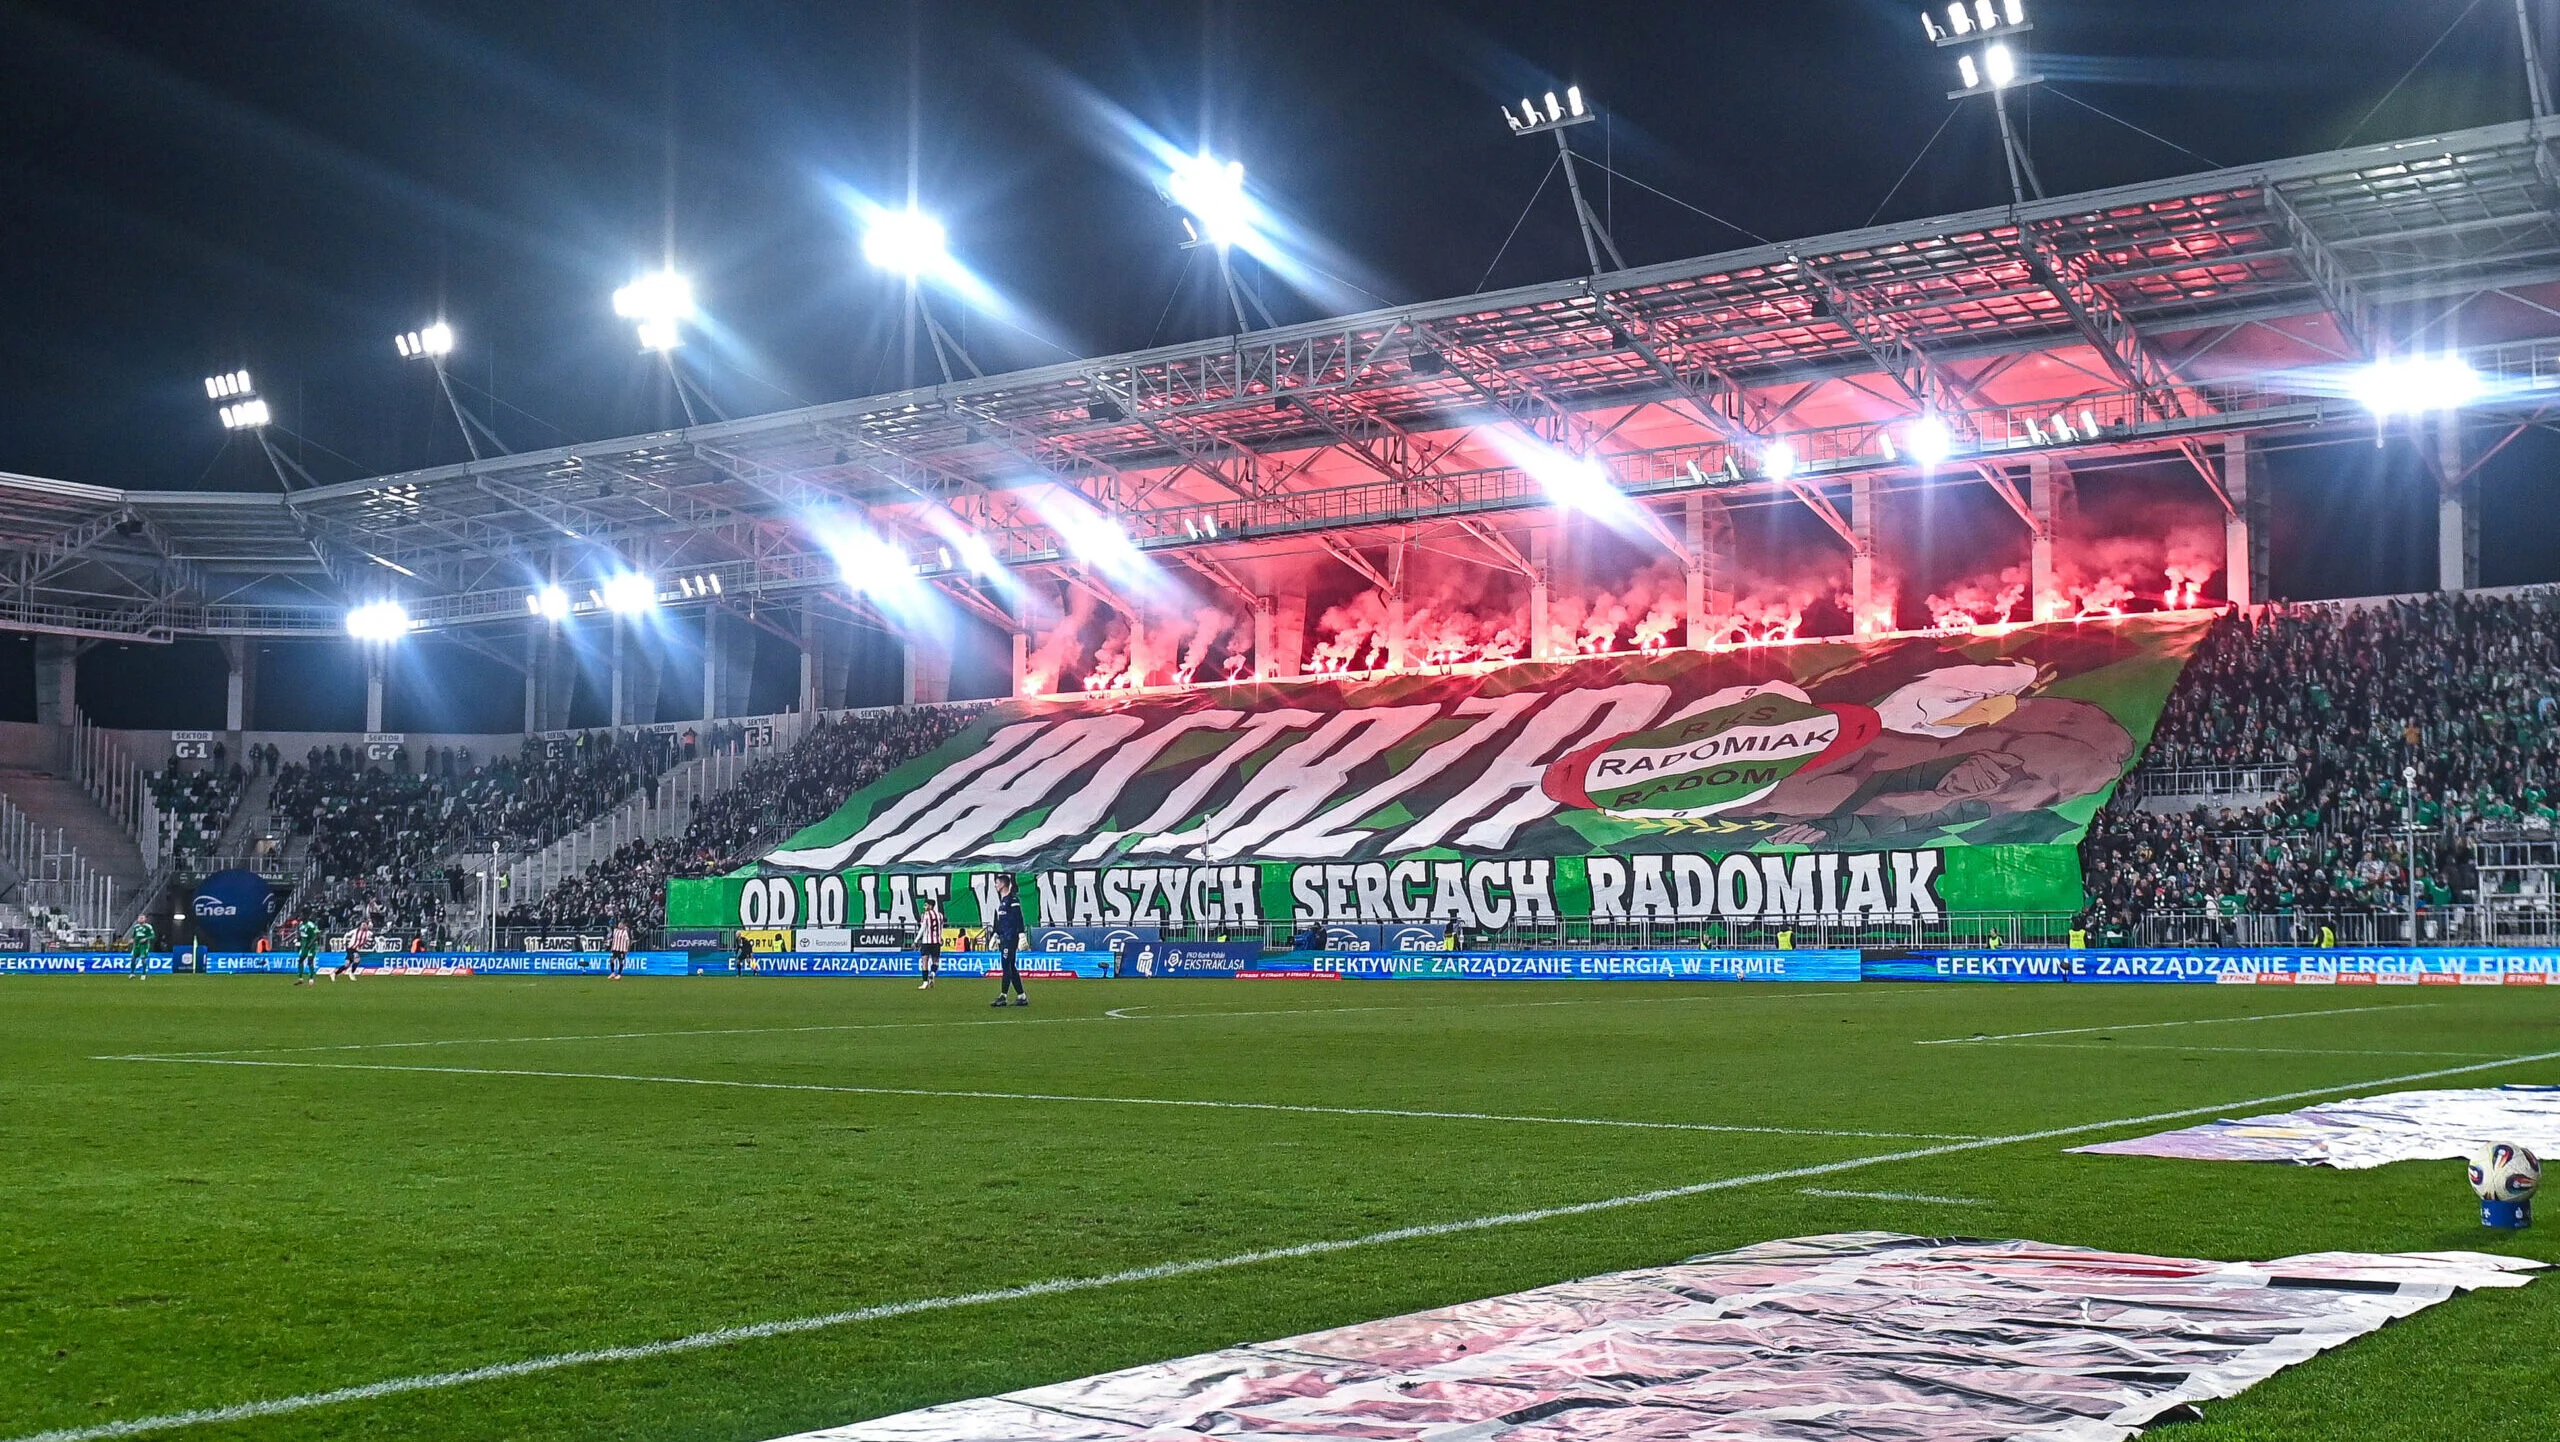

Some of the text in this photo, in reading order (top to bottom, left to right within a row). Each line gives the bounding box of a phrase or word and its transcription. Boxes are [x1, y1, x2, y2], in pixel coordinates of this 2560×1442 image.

[1680, 706, 1778, 738] RKS
[176, 742, 208, 758] G-1
[368, 744, 398, 760] G-7
[1596, 728, 1836, 778] RADOMIAK
[1612, 767, 1778, 807] RADOM
[741, 877, 794, 929] OD
[805, 876, 844, 929] 10
[861, 874, 946, 929] LAT
[1038, 867, 1258, 929] NASZYCH
[1293, 860, 1554, 928] SERCACH
[1586, 850, 1941, 927] RADOMIAK
[195, 904, 237, 916] Enea
[860, 935, 895, 945] CANAL+
[1046, 939, 1086, 952] Enea
[1325, 937, 1371, 951] Enea
[1400, 937, 1447, 951] Enea
[273, 958, 283, 968] W
[384, 957, 447, 969] EFEKTYWNE
[452, 957, 530, 972] ZARZĄDZANIE
[813, 957, 912, 974] ZARZĄDZANIE
[1184, 959, 1245, 970] EKSTRAKLASA
[1313, 957, 1786, 977] EFEKTYWNE ZARZĄDZANIE ENERGIĄ W FIRMIE
[1936, 957, 2086, 975] EFEKTYWNE
[2096, 957, 2289, 979] ZARZĄDZANIE
[2438, 957, 2467, 974] W
